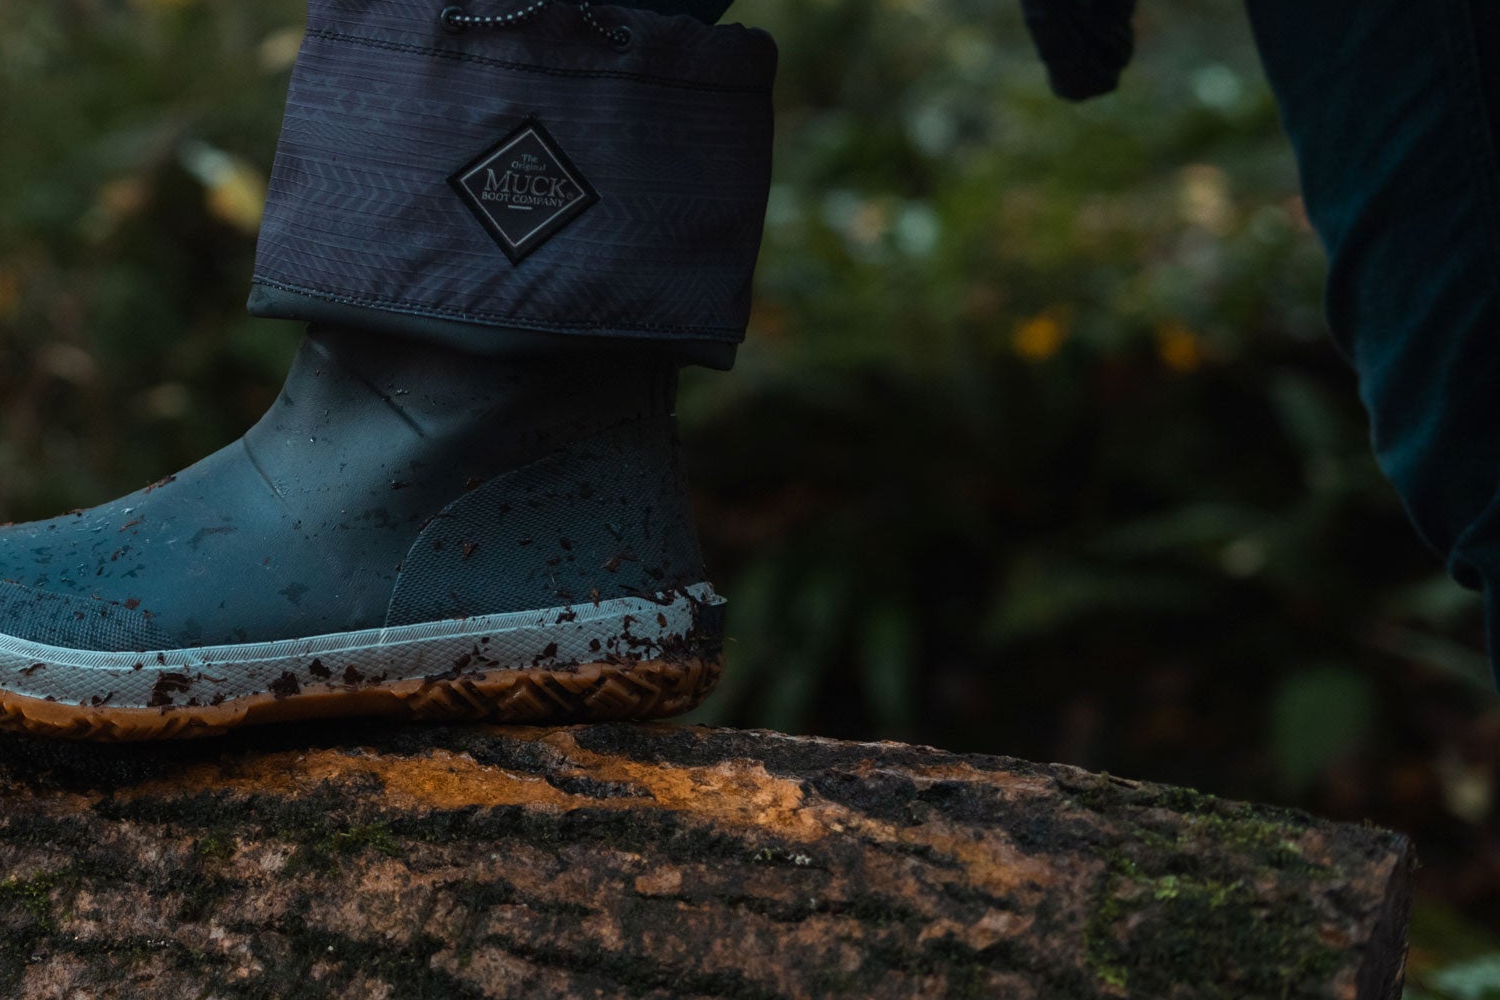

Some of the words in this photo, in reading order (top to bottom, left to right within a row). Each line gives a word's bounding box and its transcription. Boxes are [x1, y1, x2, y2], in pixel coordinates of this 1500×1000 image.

[521, 153, 538, 162] The
[511, 161, 546, 172] Original
[481, 191, 509, 202] BOOT
[512, 194, 565, 207] COMPANY
